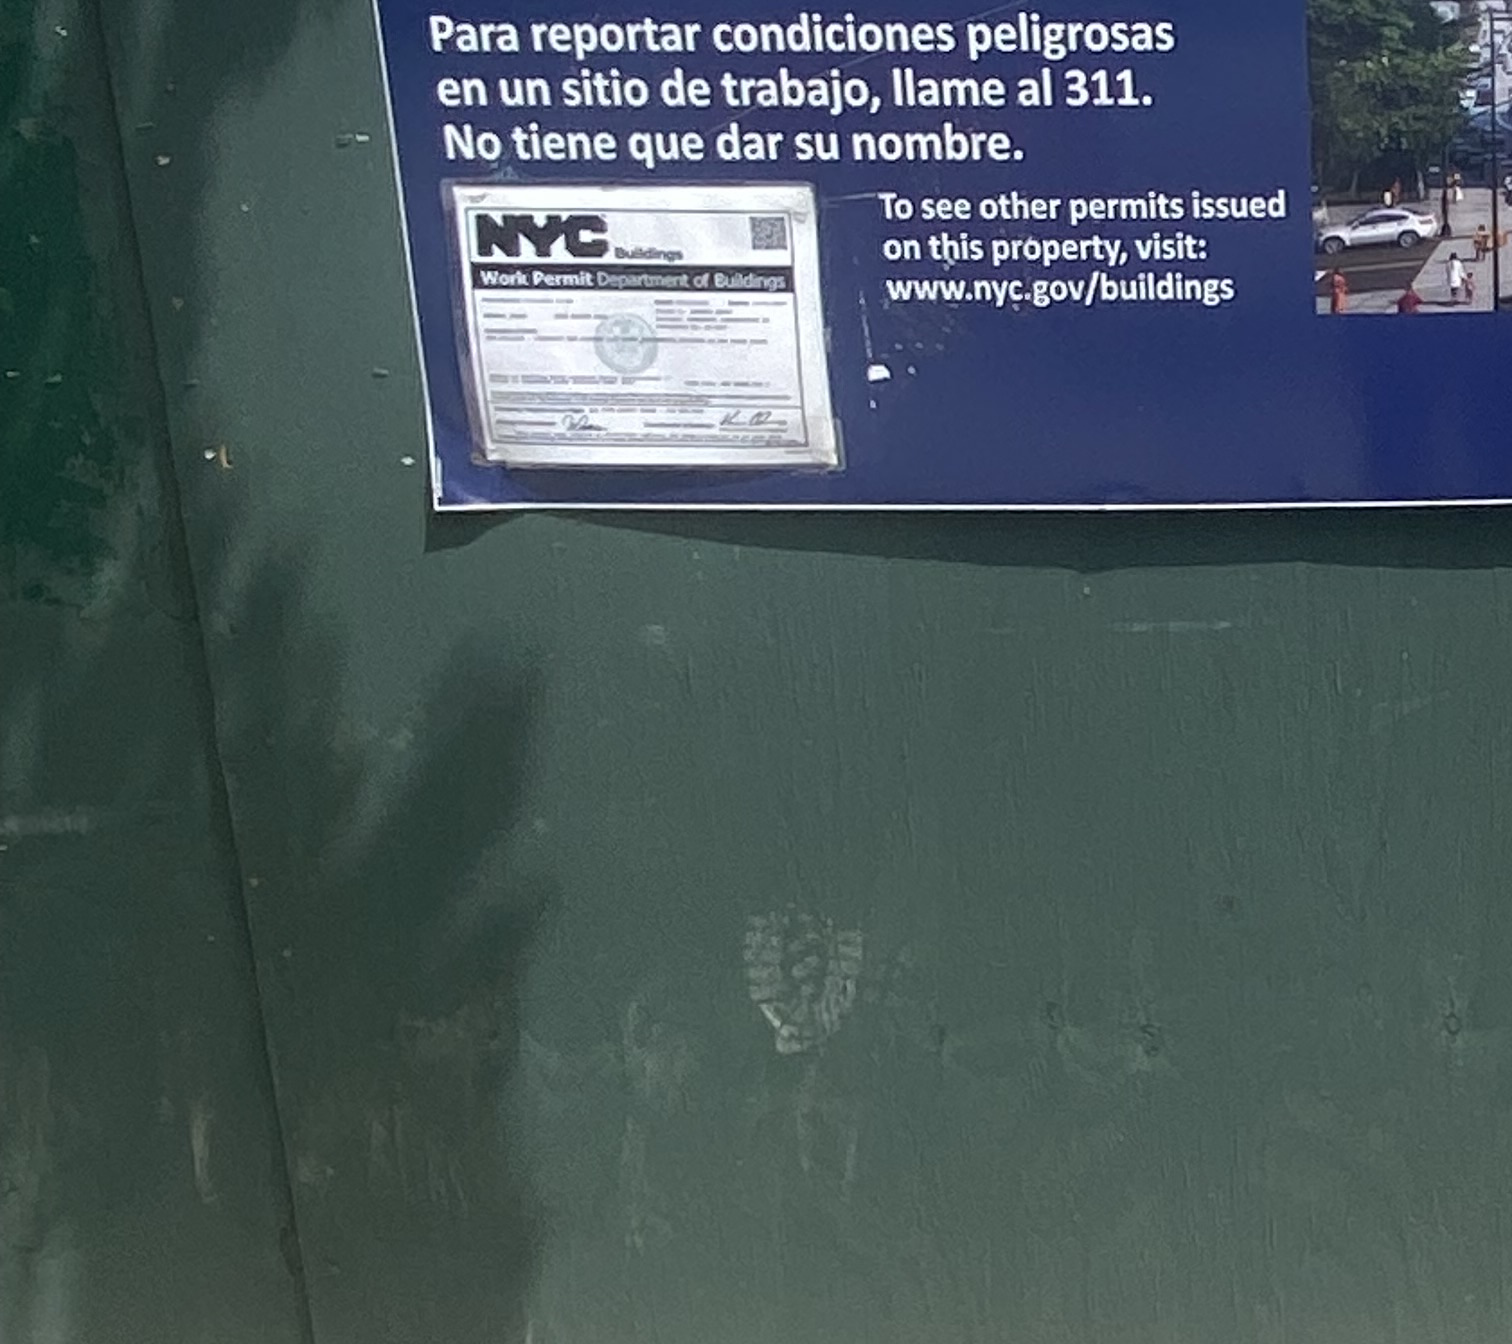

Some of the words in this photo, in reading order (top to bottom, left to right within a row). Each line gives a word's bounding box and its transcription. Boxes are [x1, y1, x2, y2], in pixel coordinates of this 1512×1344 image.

[429, 14, 520, 54] Para
[530, 15, 702, 63] reportar
[712, 12, 956, 55] condiciones
[966, 11, 1174, 61] peligrosas
[436, 77, 488, 107] en
[497, 77, 552, 107] un
[562, 66, 650, 107] sitio
[660, 67, 711, 107] de
[719, 65, 881, 119] trabajo,
[890, 66, 1006, 107] llame
[1016, 67, 1052, 107] al
[1064, 68, 1152, 106] 311.
[442, 123, 502, 161] No
[507, 122, 617, 161] tiene
[627, 131, 705, 173] que
[716, 120, 784, 161] dar
[790, 132, 840, 161] su
[852, 118, 1023, 161] nombre.
[879, 194, 913, 220] To
[920, 198, 971, 220] see
[979, 190, 1061, 220] other
[1068, 191, 1185, 226] permits
[1188, 189, 1286, 220] issued
[475, 214, 608, 258] NYC
[615, 247, 683, 261] Buildings
[882, 239, 921, 260] on
[929, 231, 984, 261] this
[991, 233, 1128, 267] property,
[1134, 231, 1207, 260] visit:
[480, 270, 529, 287] Work
[533, 271, 594, 287] Permit
[597, 271, 689, 292] Department
[694, 272, 711, 288] of
[714, 273, 786, 291] Buildings
[886, 269, 1234, 308] www.nyc.gov/buildings
